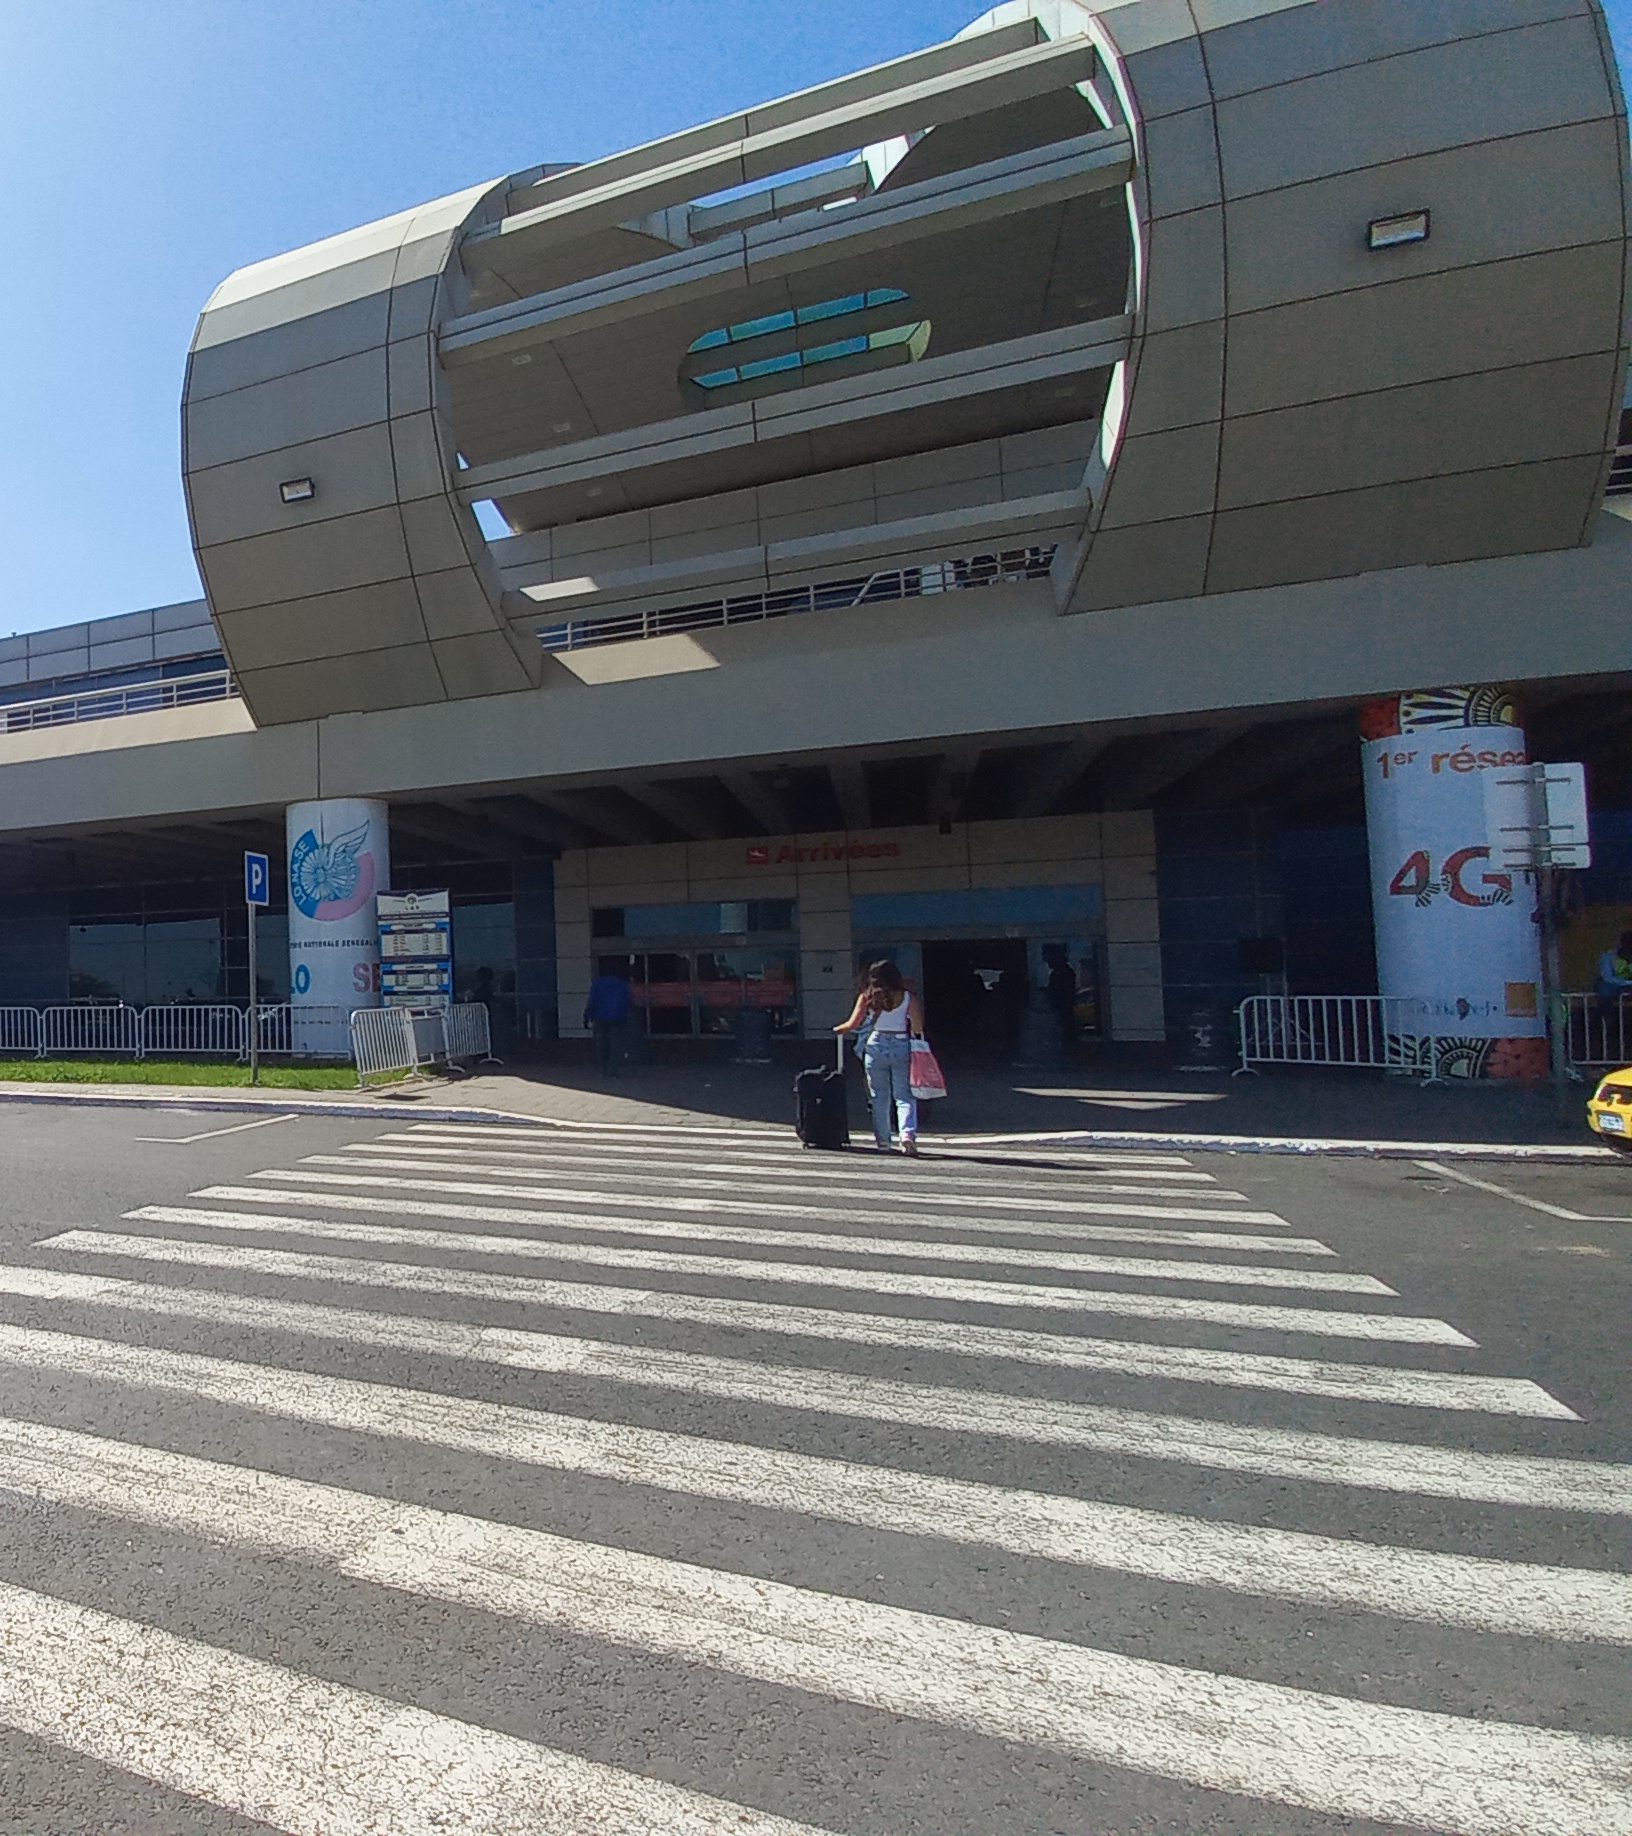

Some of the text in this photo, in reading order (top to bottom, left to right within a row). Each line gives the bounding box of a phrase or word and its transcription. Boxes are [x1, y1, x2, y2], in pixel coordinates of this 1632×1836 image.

[1376, 750, 1418, 779] 1er
[775, 838, 902, 864] Arrivées
[252, 863, 263, 894] P
[1388, 845, 1514, 908] 4G
